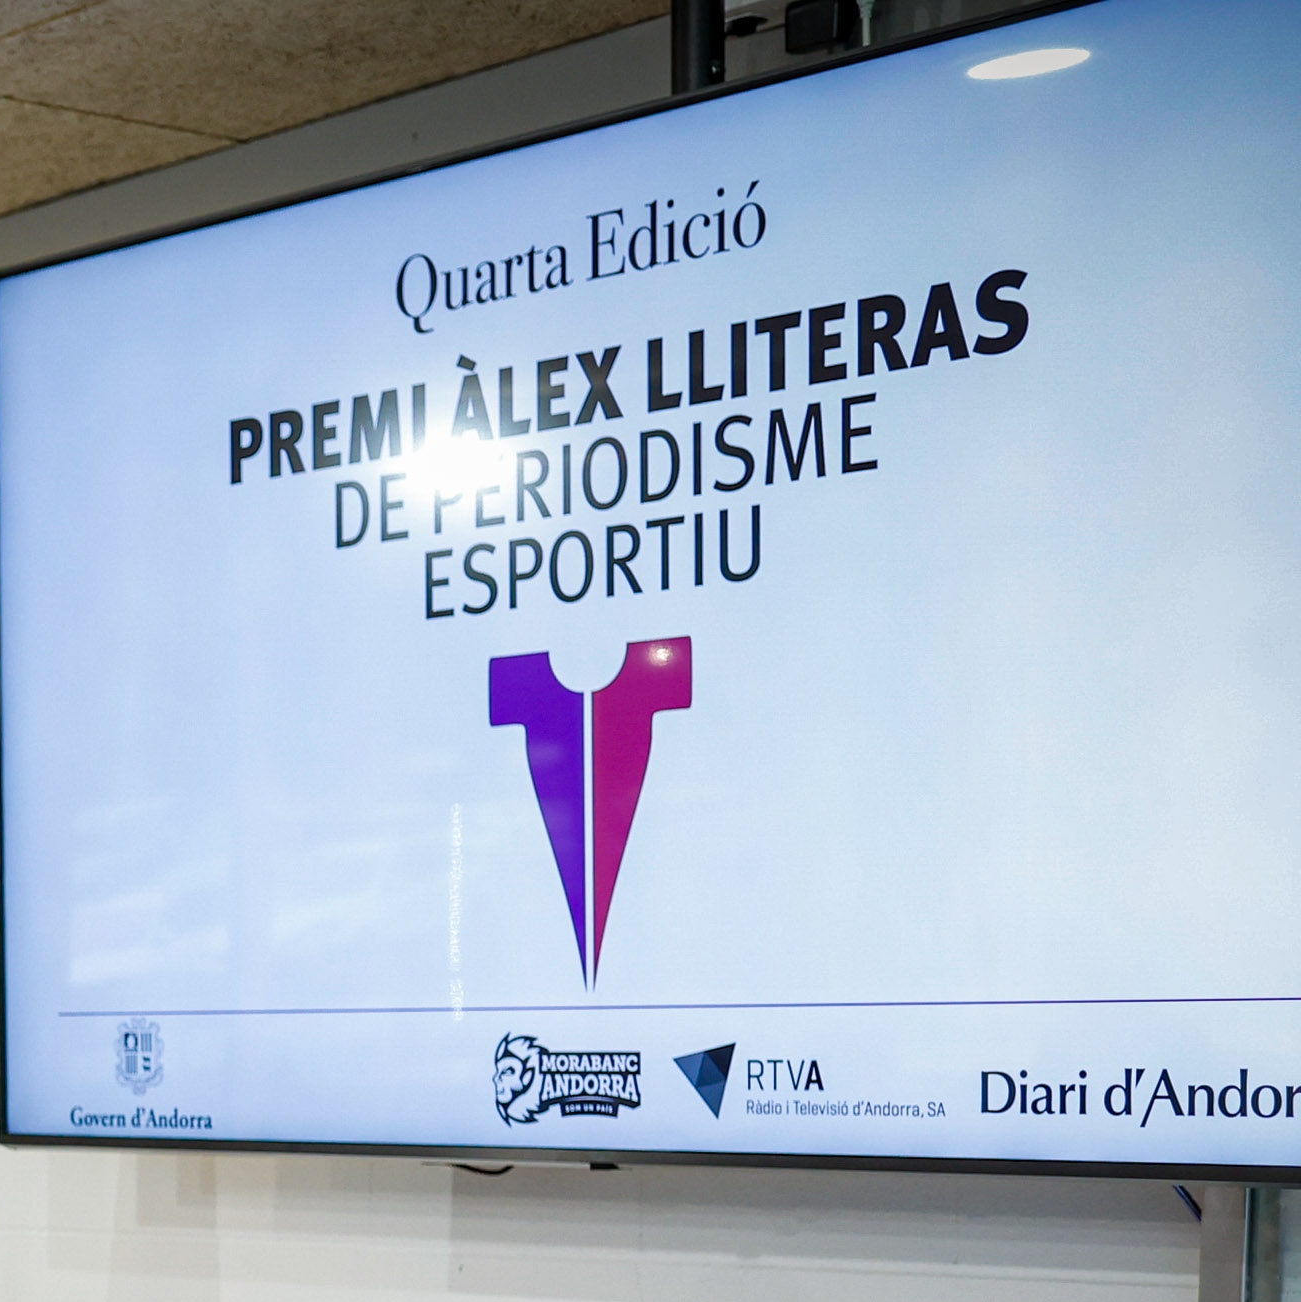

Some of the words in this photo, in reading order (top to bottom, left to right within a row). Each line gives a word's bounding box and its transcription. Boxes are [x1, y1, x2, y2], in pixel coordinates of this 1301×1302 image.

[396, 244, 574, 334] Quarta
[585, 180, 767, 282] Edició
[229, 382, 427, 486] PREMI
[450, 345, 625, 441] ÀLEX
[645, 269, 1030, 415] LLITERAS
[335, 472, 410, 550] DE
[424, 504, 763, 620] ESPORTIU
[540, 1053, 639, 1073] MORABANC
[746, 1059, 825, 1092] RTVA
[540, 1073, 640, 1102] ANDORRA
[980, 1069, 1088, 1116] Diari
[69, 1105, 127, 1128] Govern
[130, 1106, 214, 1130] d'Andorra
[746, 1099, 783, 1116] Ràdio
[793, 1100, 849, 1117] Televisió
[852, 1101, 925, 1119] d'Andorra,
[927, 1102, 947, 1118] SA
